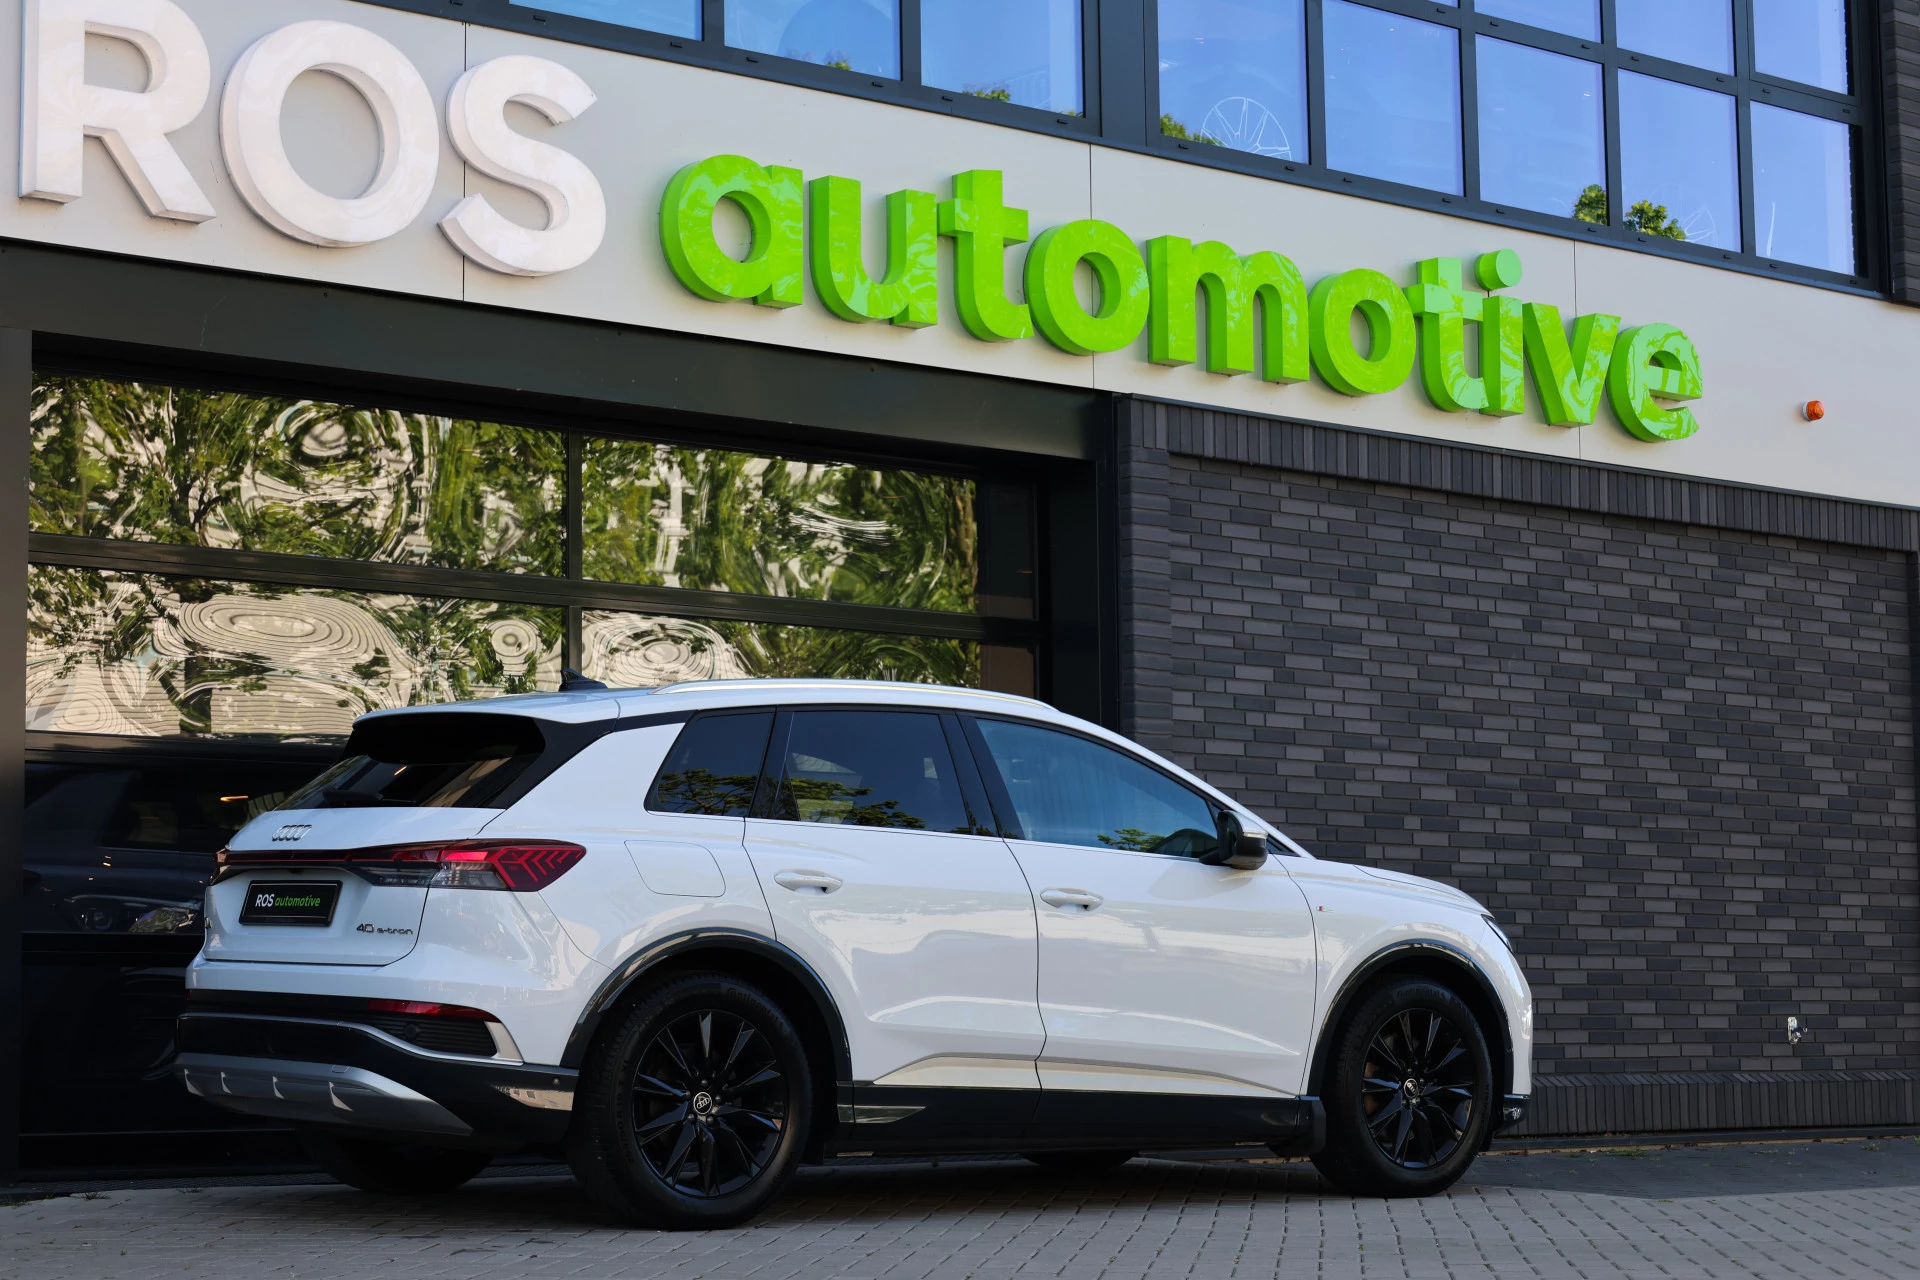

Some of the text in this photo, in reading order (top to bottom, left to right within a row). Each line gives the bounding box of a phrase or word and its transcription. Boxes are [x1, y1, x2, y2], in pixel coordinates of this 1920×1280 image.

[19, 0, 1703, 443] ROS automotive
[255, 893, 321, 907] ROS automotive
[356, 923, 413, 935] 40 e-tron
